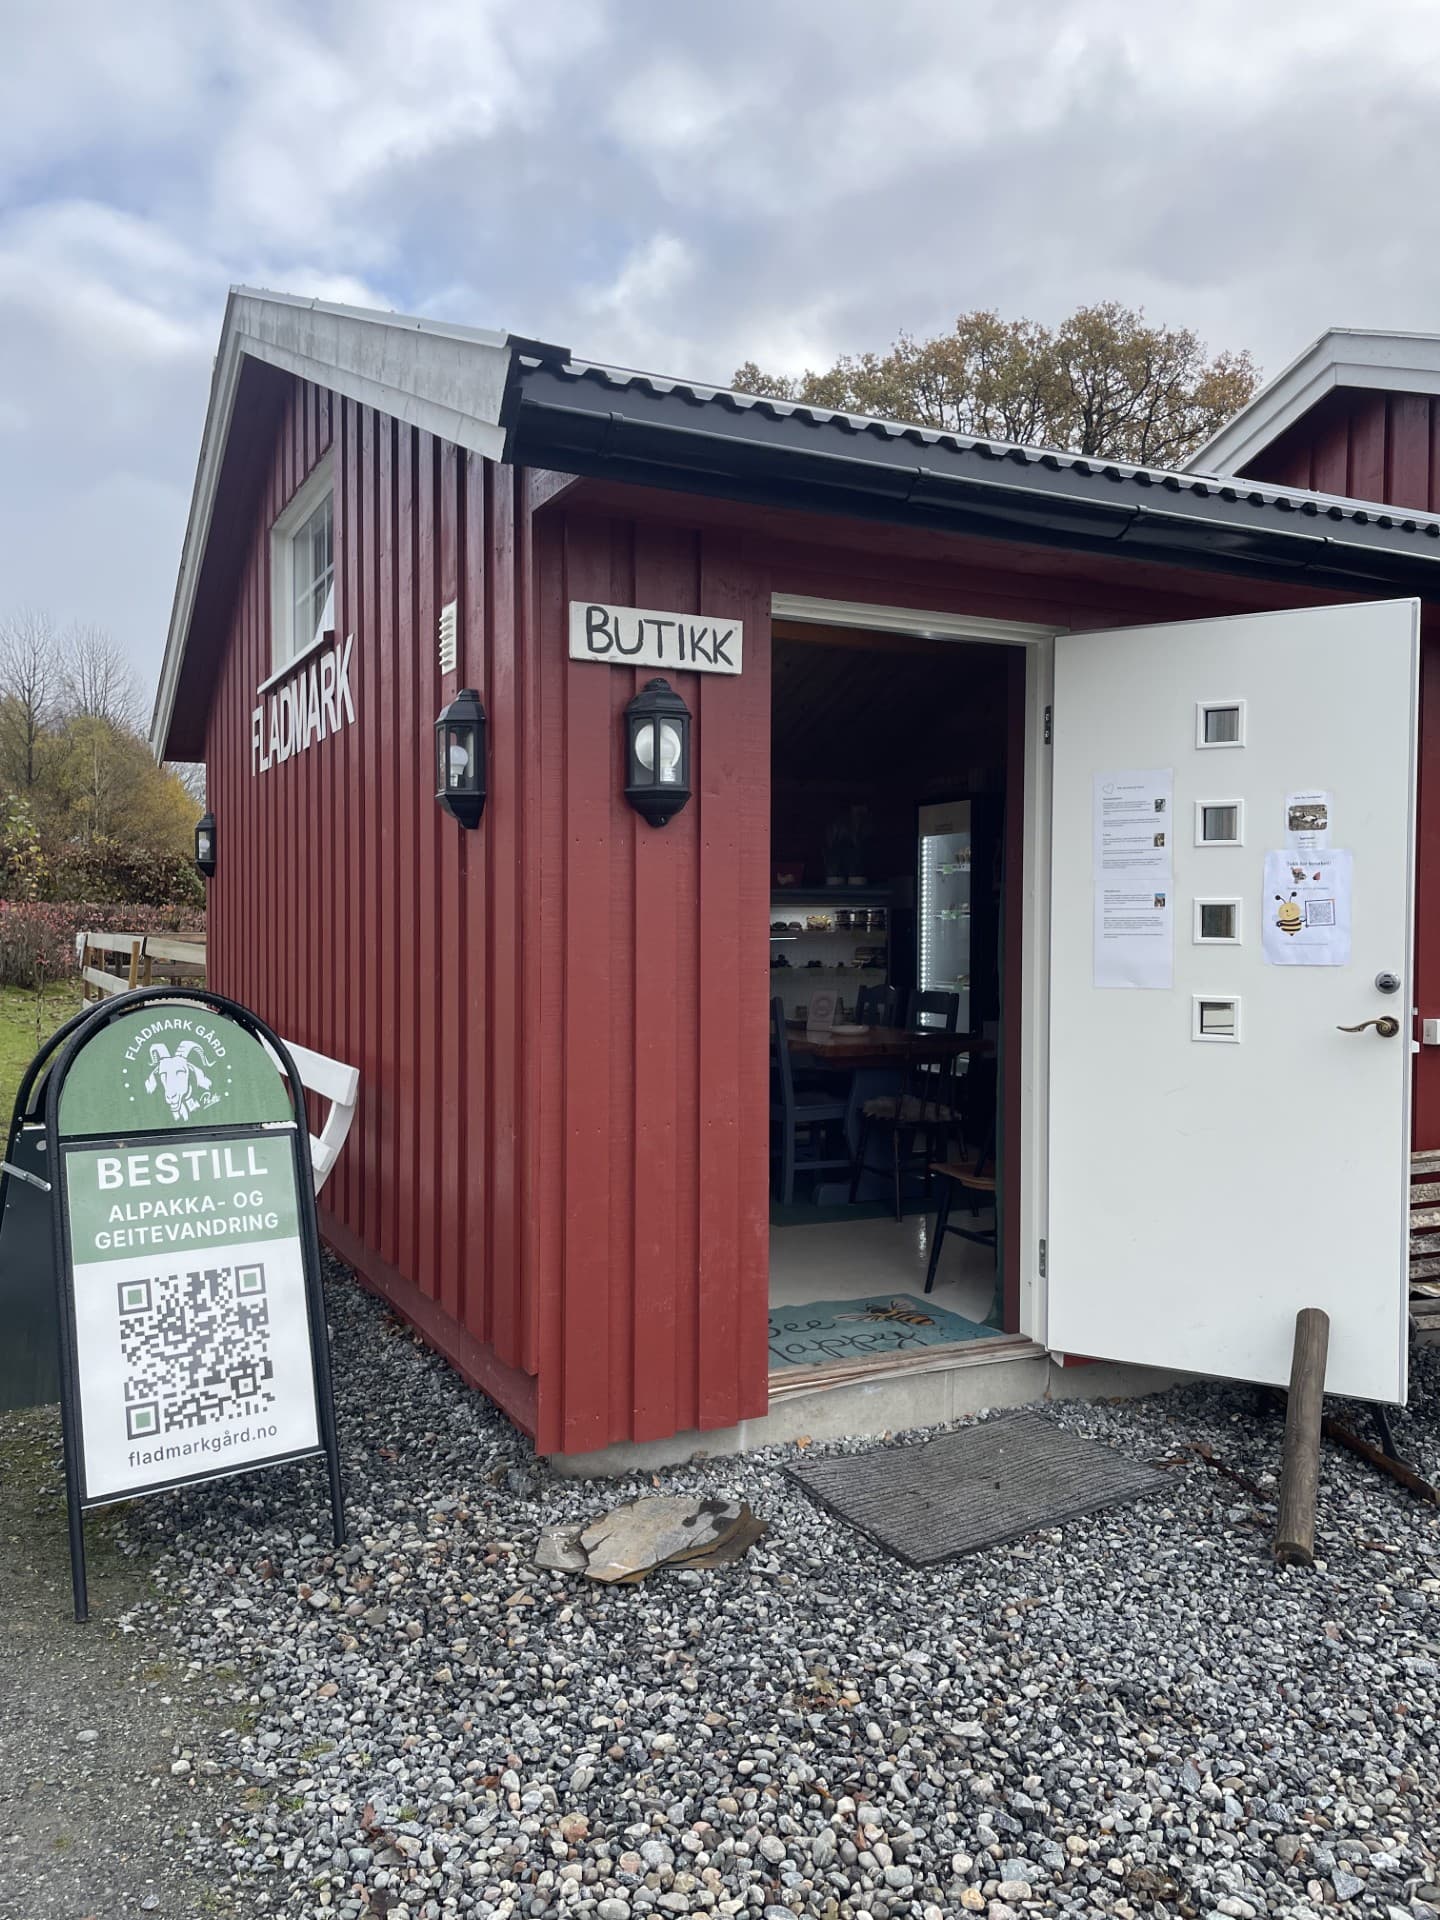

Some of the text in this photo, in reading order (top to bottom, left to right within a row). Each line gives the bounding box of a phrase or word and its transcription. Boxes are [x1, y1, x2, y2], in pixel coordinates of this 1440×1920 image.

[584, 605, 734, 667] BUTIKK
[251, 632, 356, 777] FLADMARK
[125, 1018, 226, 1061] FLADMARK GÅRD
[96, 1146, 268, 1190] BESTILL
[108, 1189, 264, 1223] ALPAKKA- OG
[94, 1212, 279, 1250] GEITEVANDRING
[128, 1424, 278, 1468] fladmarkgård.no
